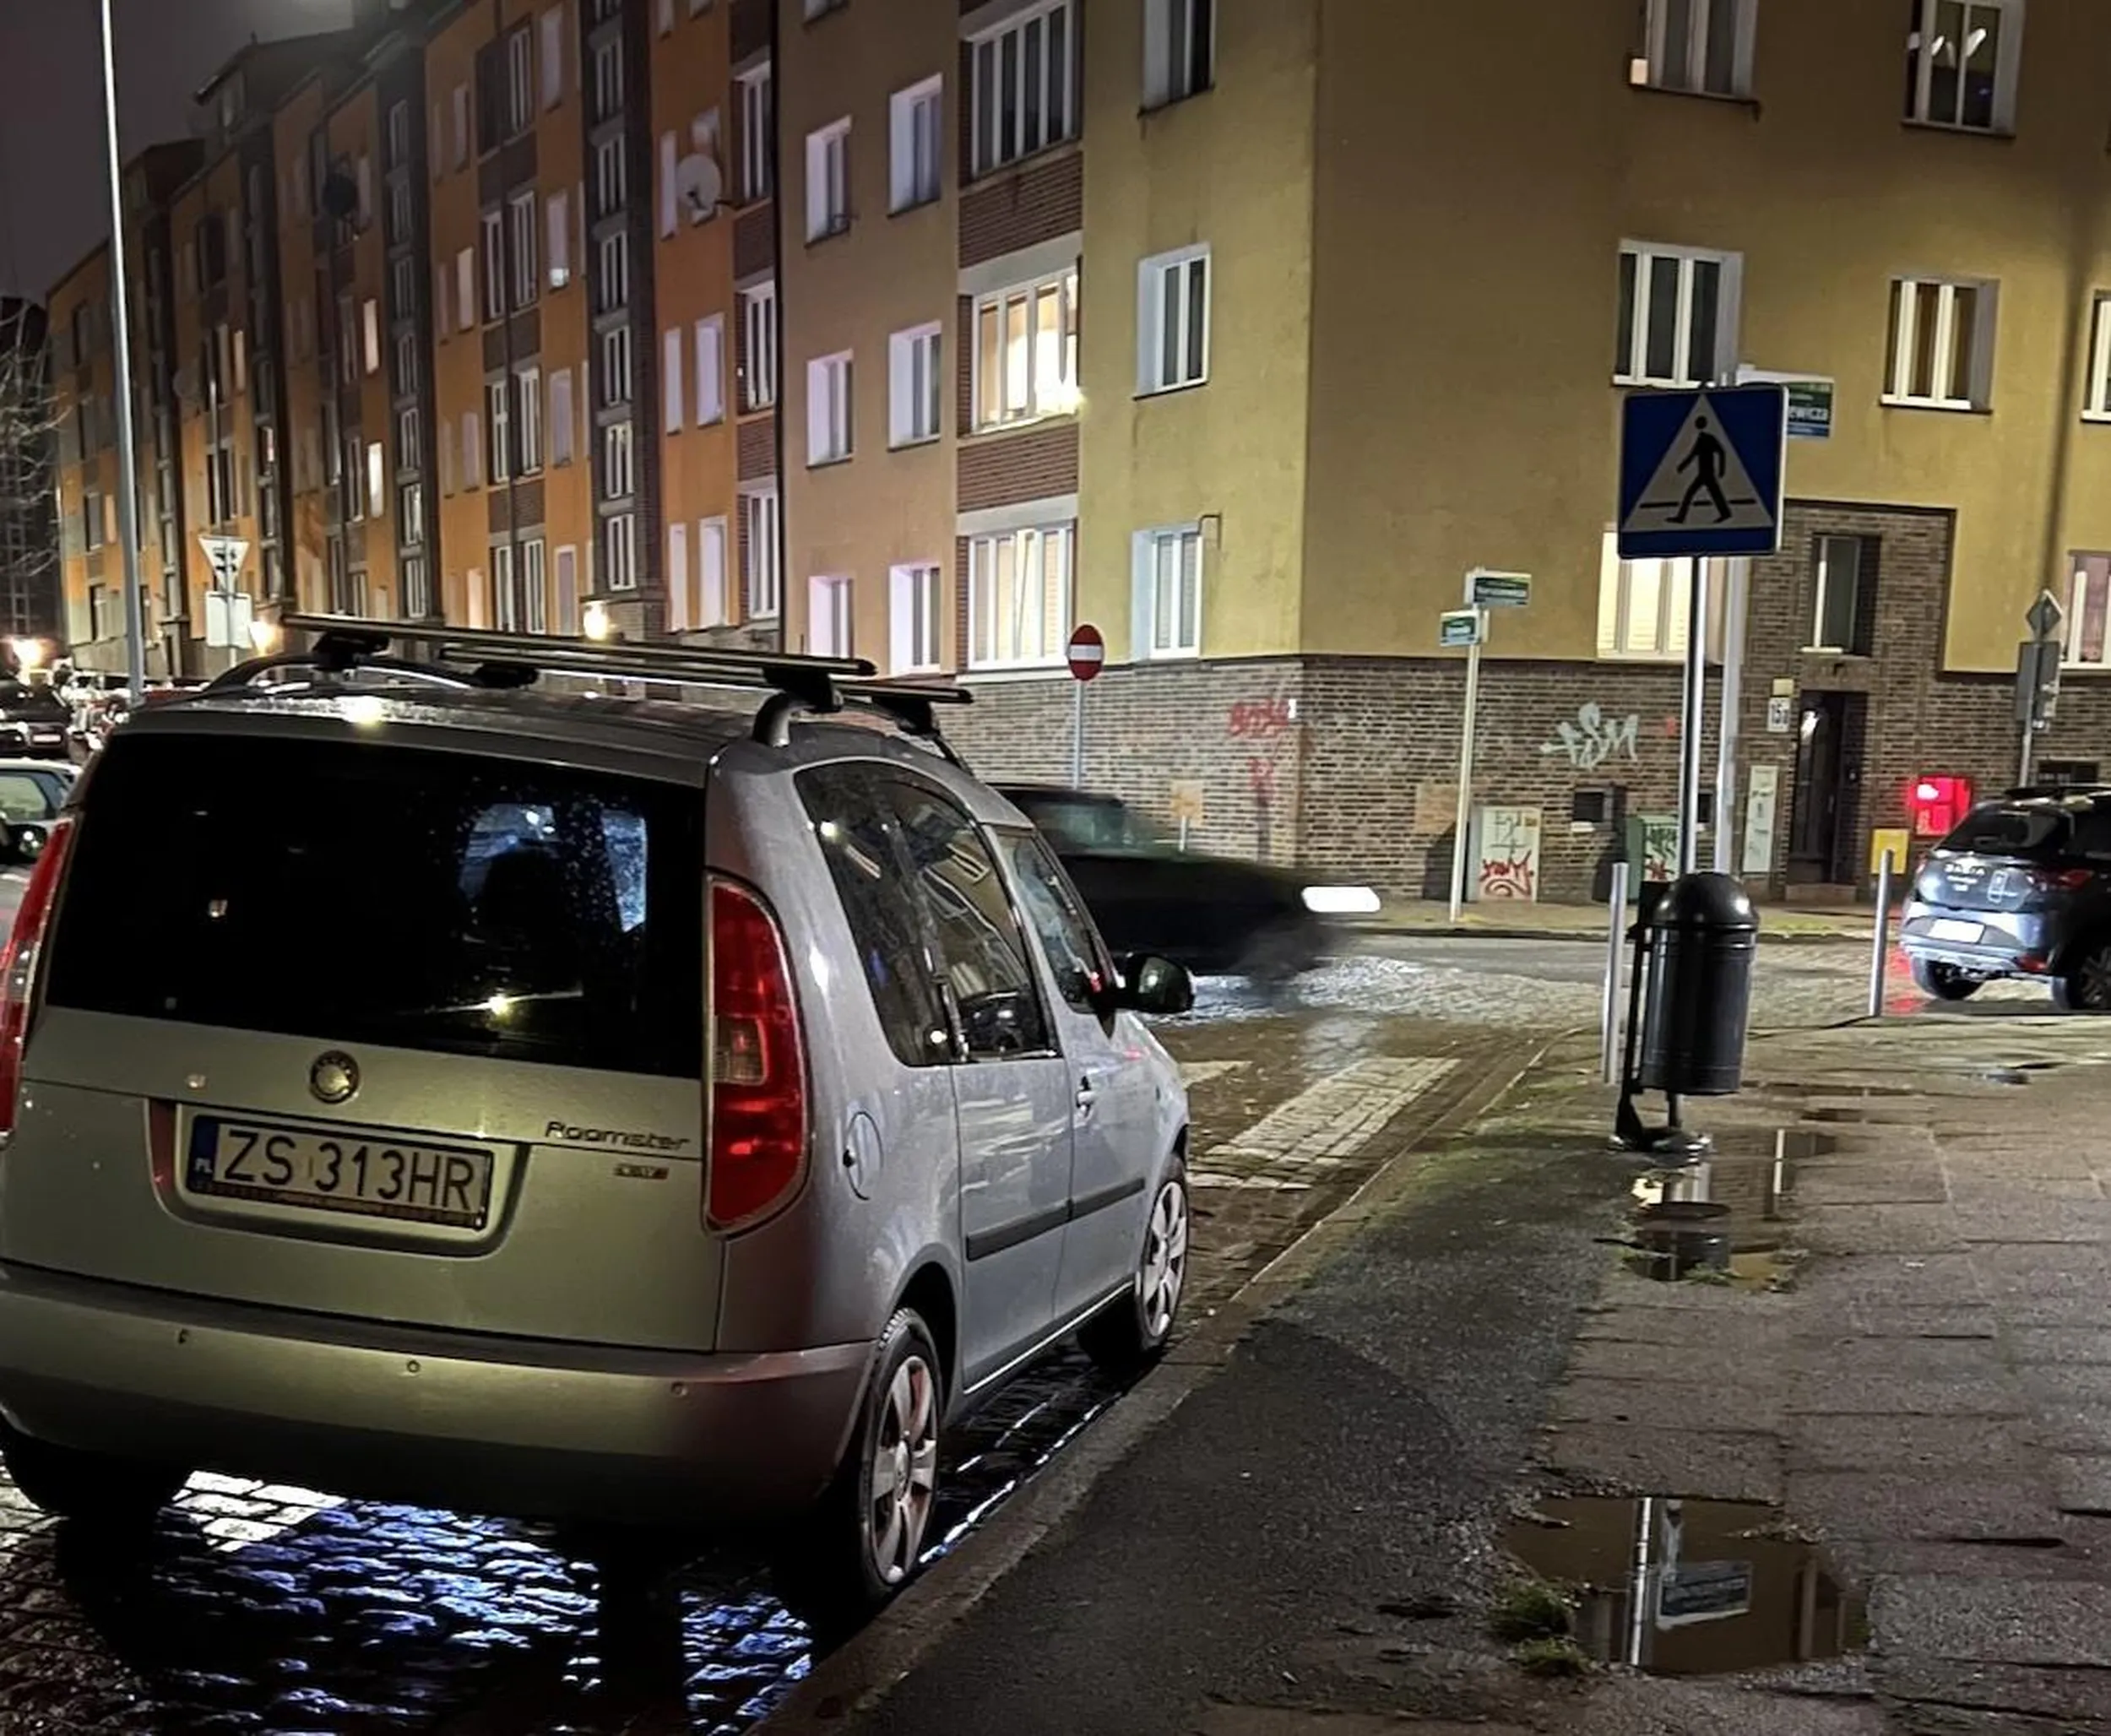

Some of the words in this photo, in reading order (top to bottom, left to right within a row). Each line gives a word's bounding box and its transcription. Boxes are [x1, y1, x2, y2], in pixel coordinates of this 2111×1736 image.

[544, 1120, 691, 1152] Roomster
[225, 1129, 296, 1185] ZS
[315, 1142, 475, 1211] 313HR
